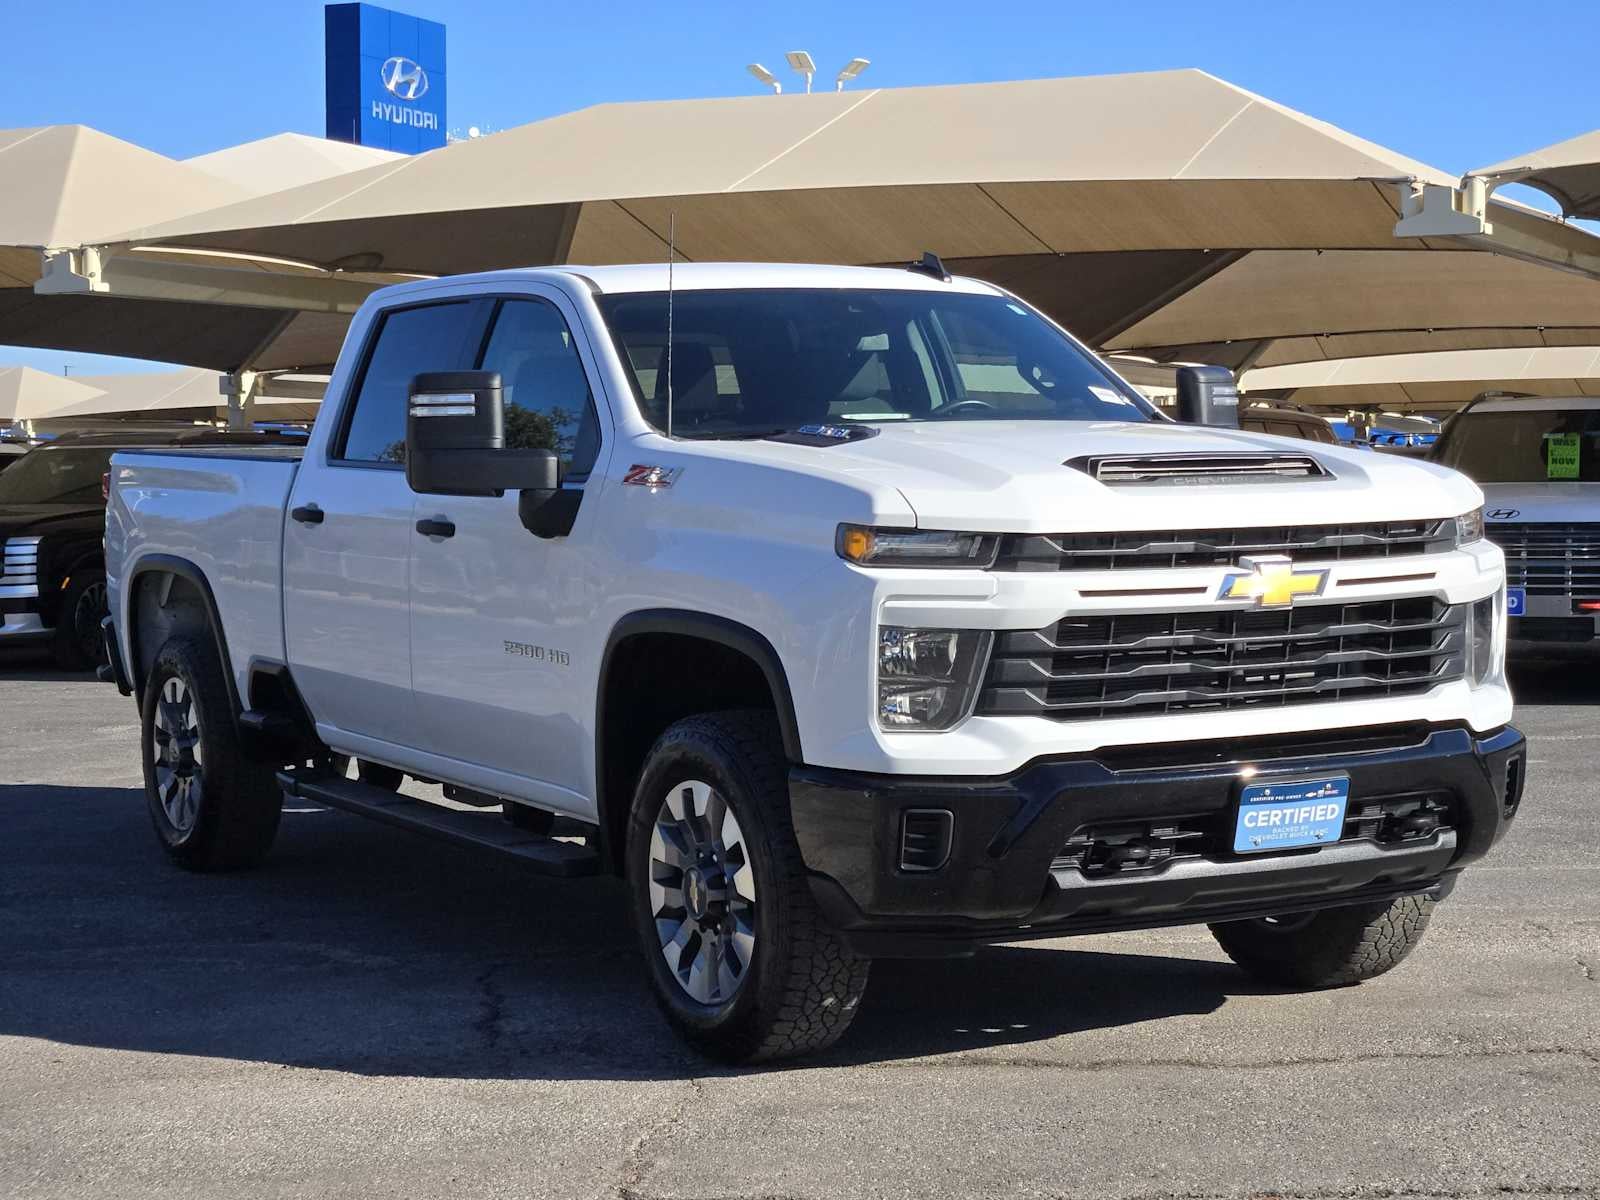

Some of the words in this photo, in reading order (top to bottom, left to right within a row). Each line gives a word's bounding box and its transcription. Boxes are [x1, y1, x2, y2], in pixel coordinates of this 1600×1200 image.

[372, 101, 438, 130] HYUNDAI
[1551, 457, 1576, 465] NOW
[1243, 803, 1340, 828] CERTIFIED
